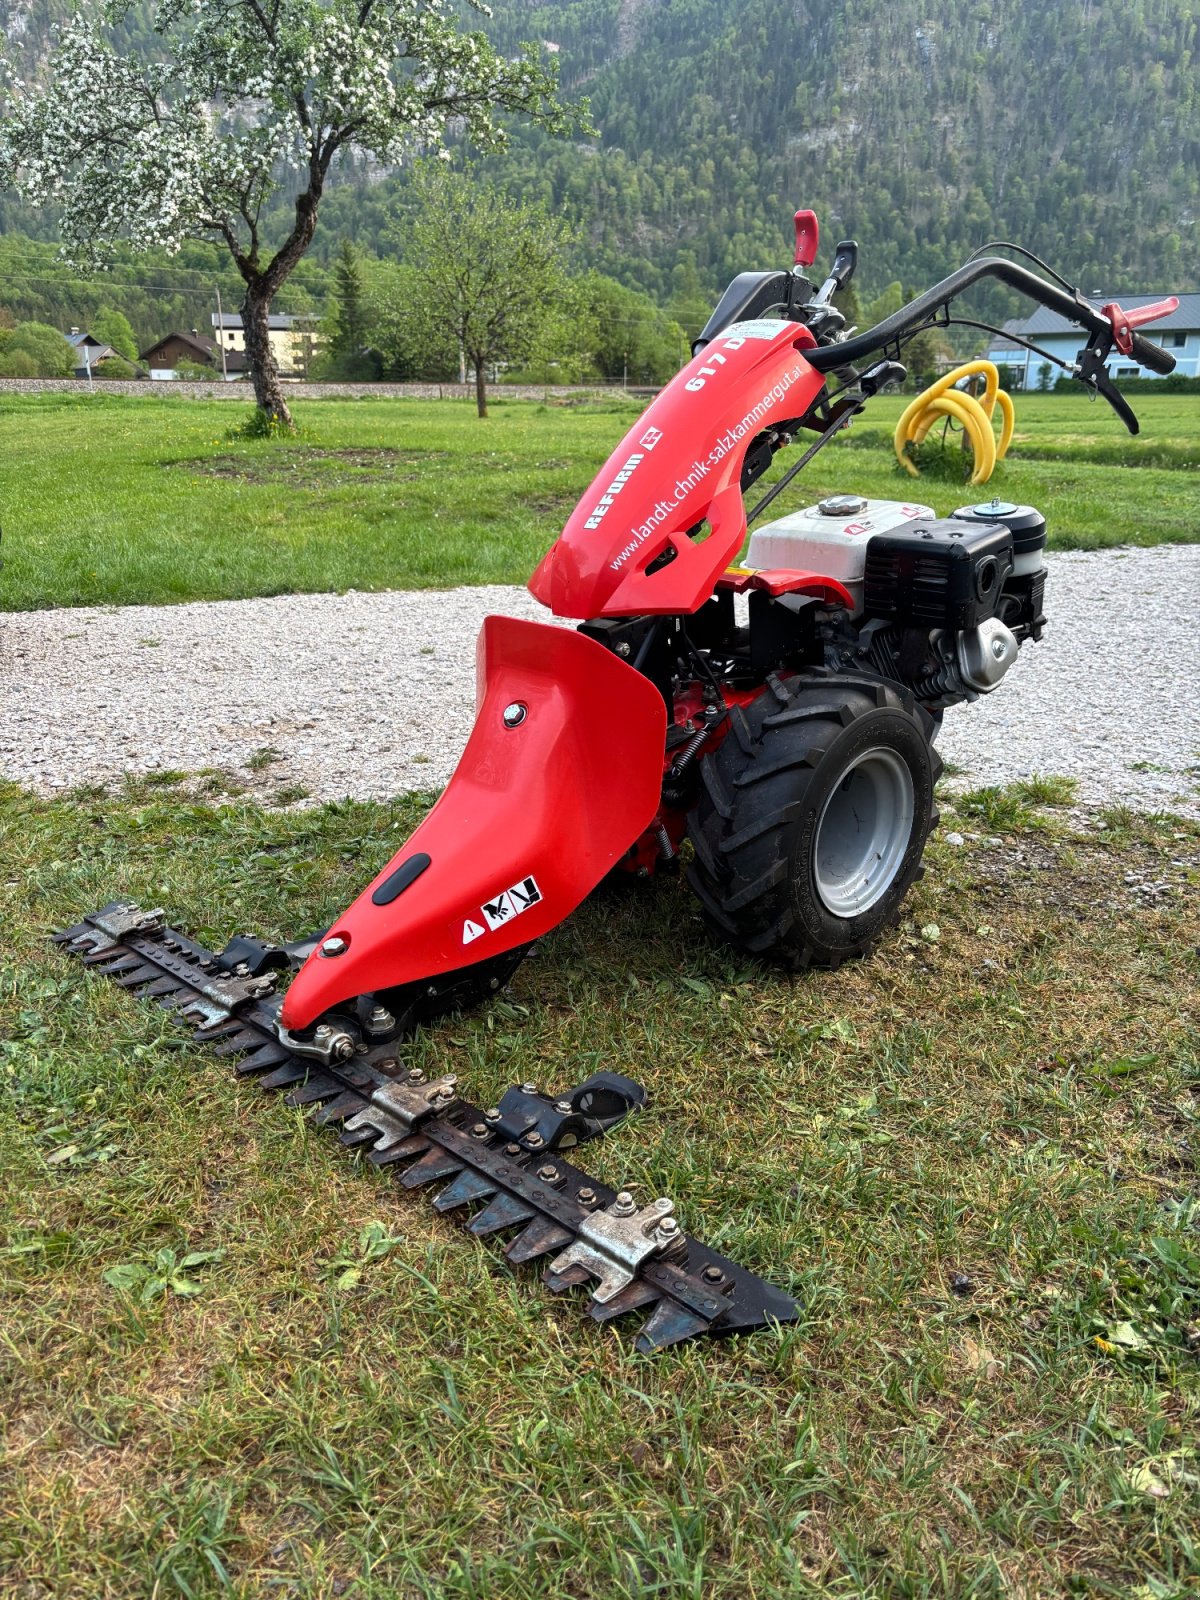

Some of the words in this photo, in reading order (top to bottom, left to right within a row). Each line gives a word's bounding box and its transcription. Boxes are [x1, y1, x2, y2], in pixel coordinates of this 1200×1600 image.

[684, 352, 727, 392] 617
[722, 337, 746, 350] D
[583, 453, 645, 530] REFORM
